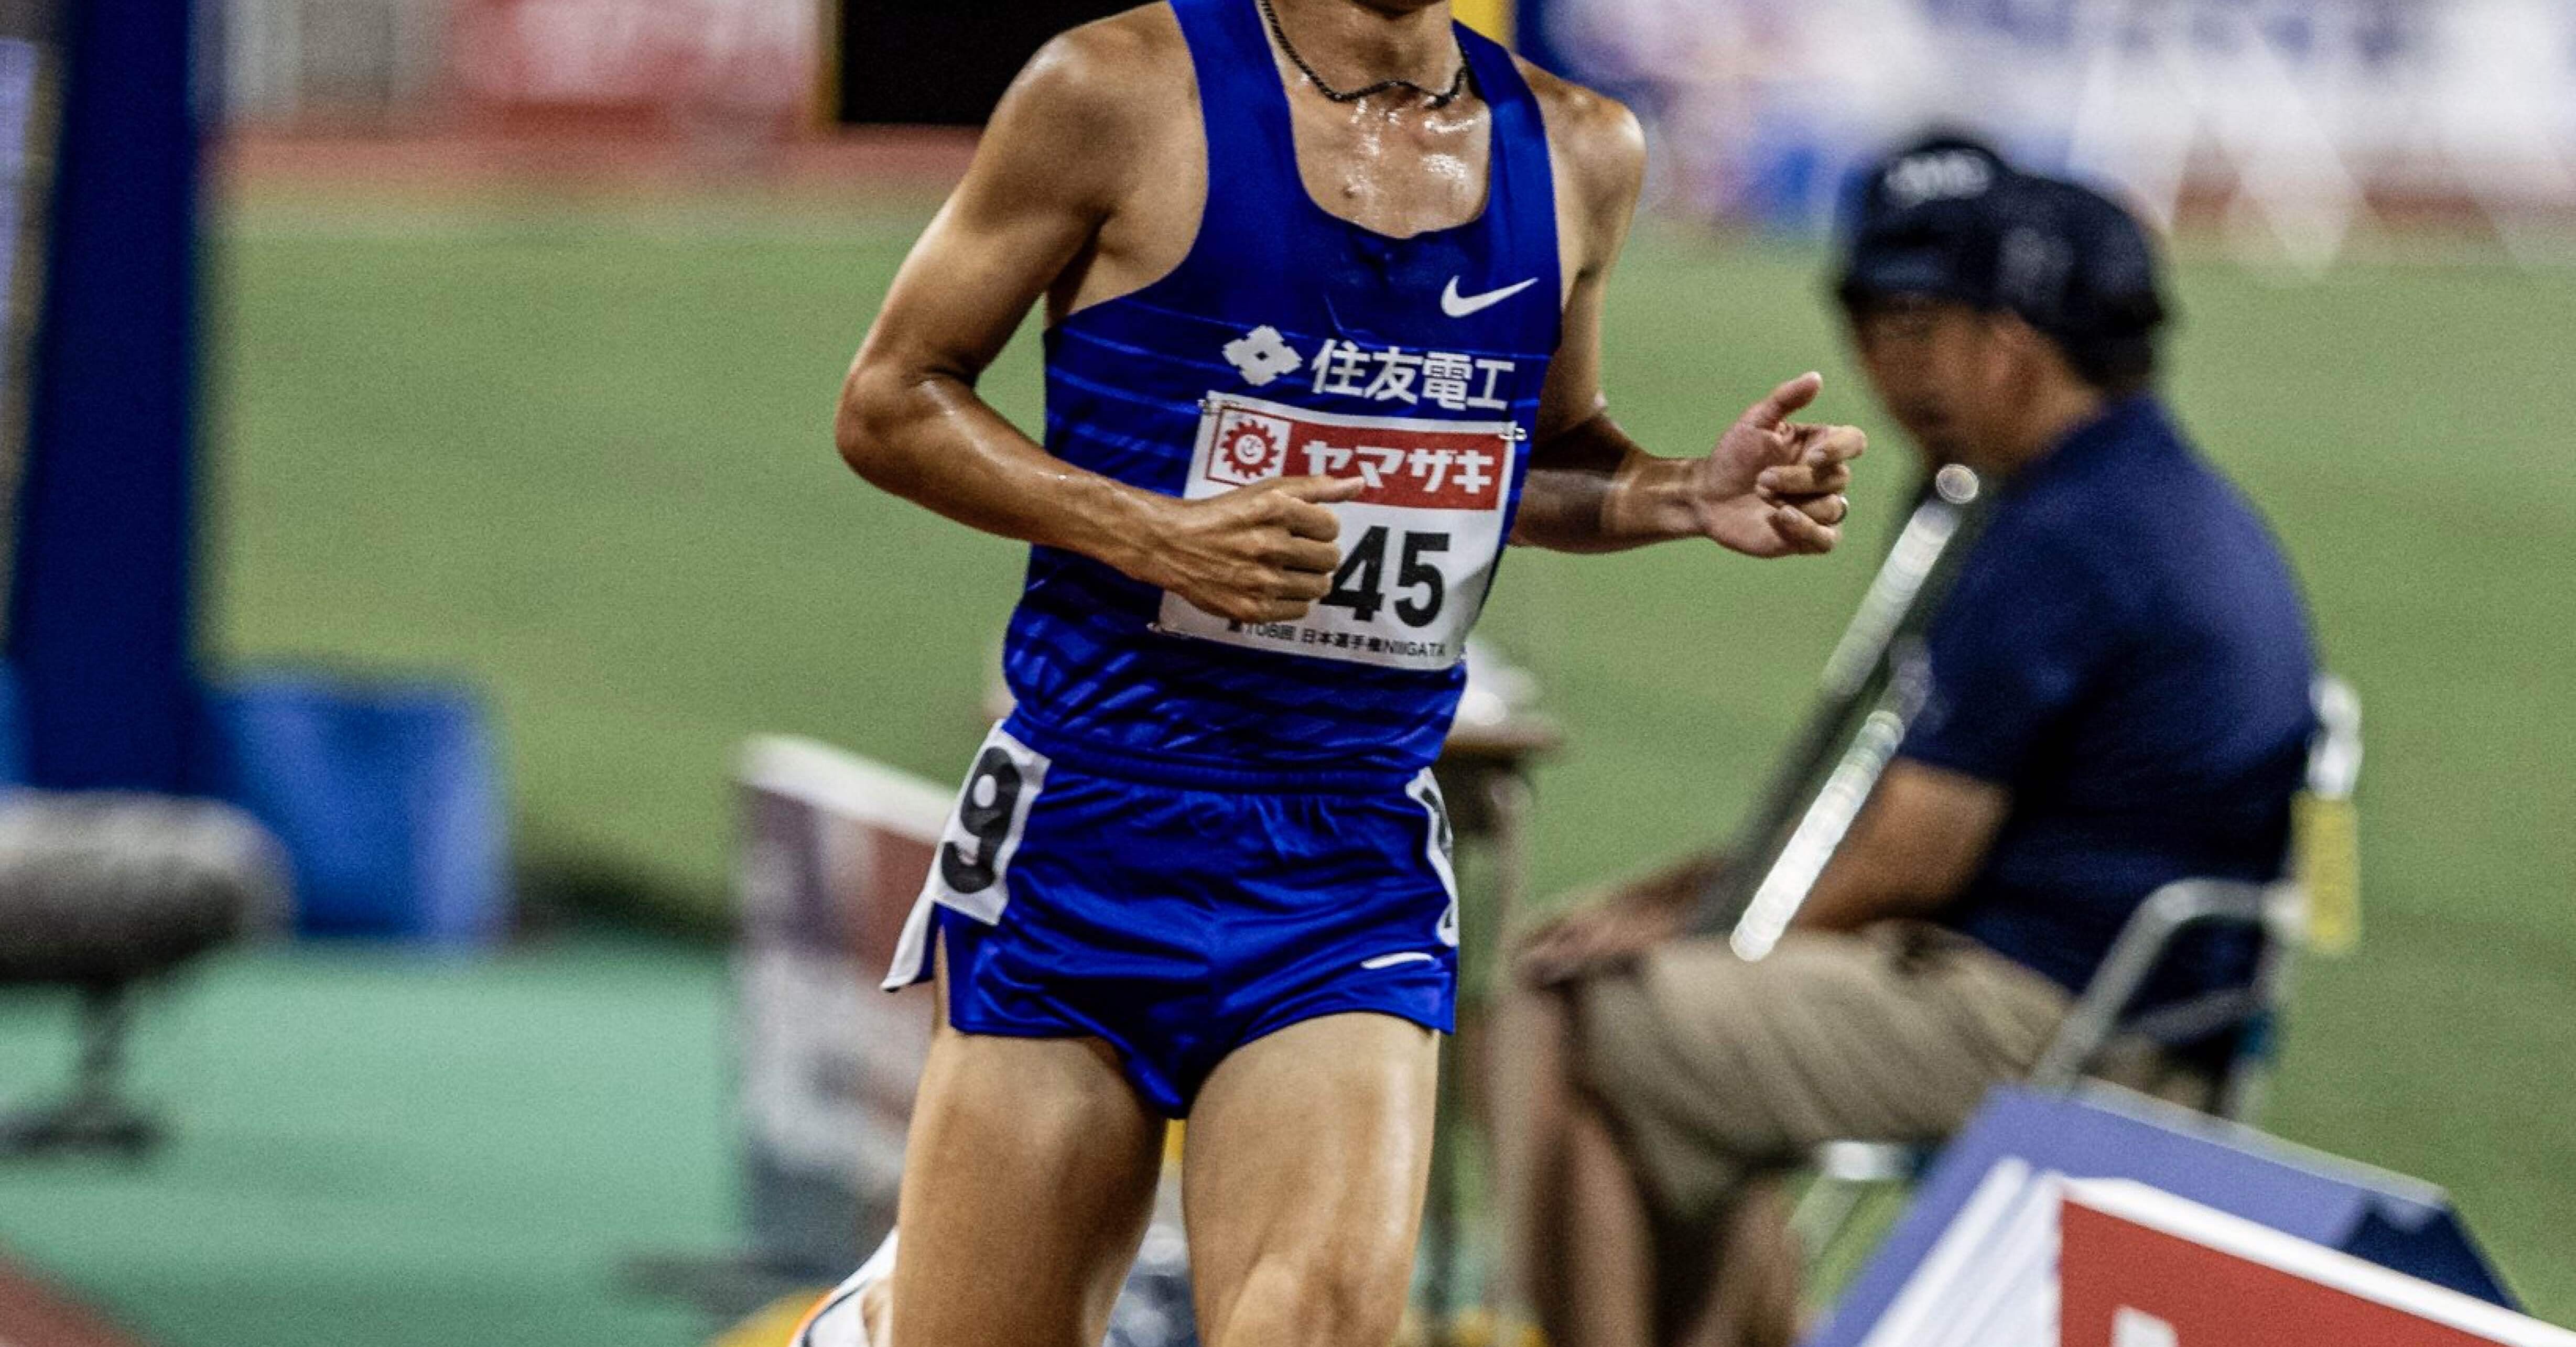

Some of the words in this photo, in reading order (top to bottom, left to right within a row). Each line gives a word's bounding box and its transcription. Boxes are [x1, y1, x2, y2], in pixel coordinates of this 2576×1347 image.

[1311, 339, 1515, 410] 住友電工
[1302, 440, 1493, 494] ヤマザキ
[941, 747, 1021, 894] 9
